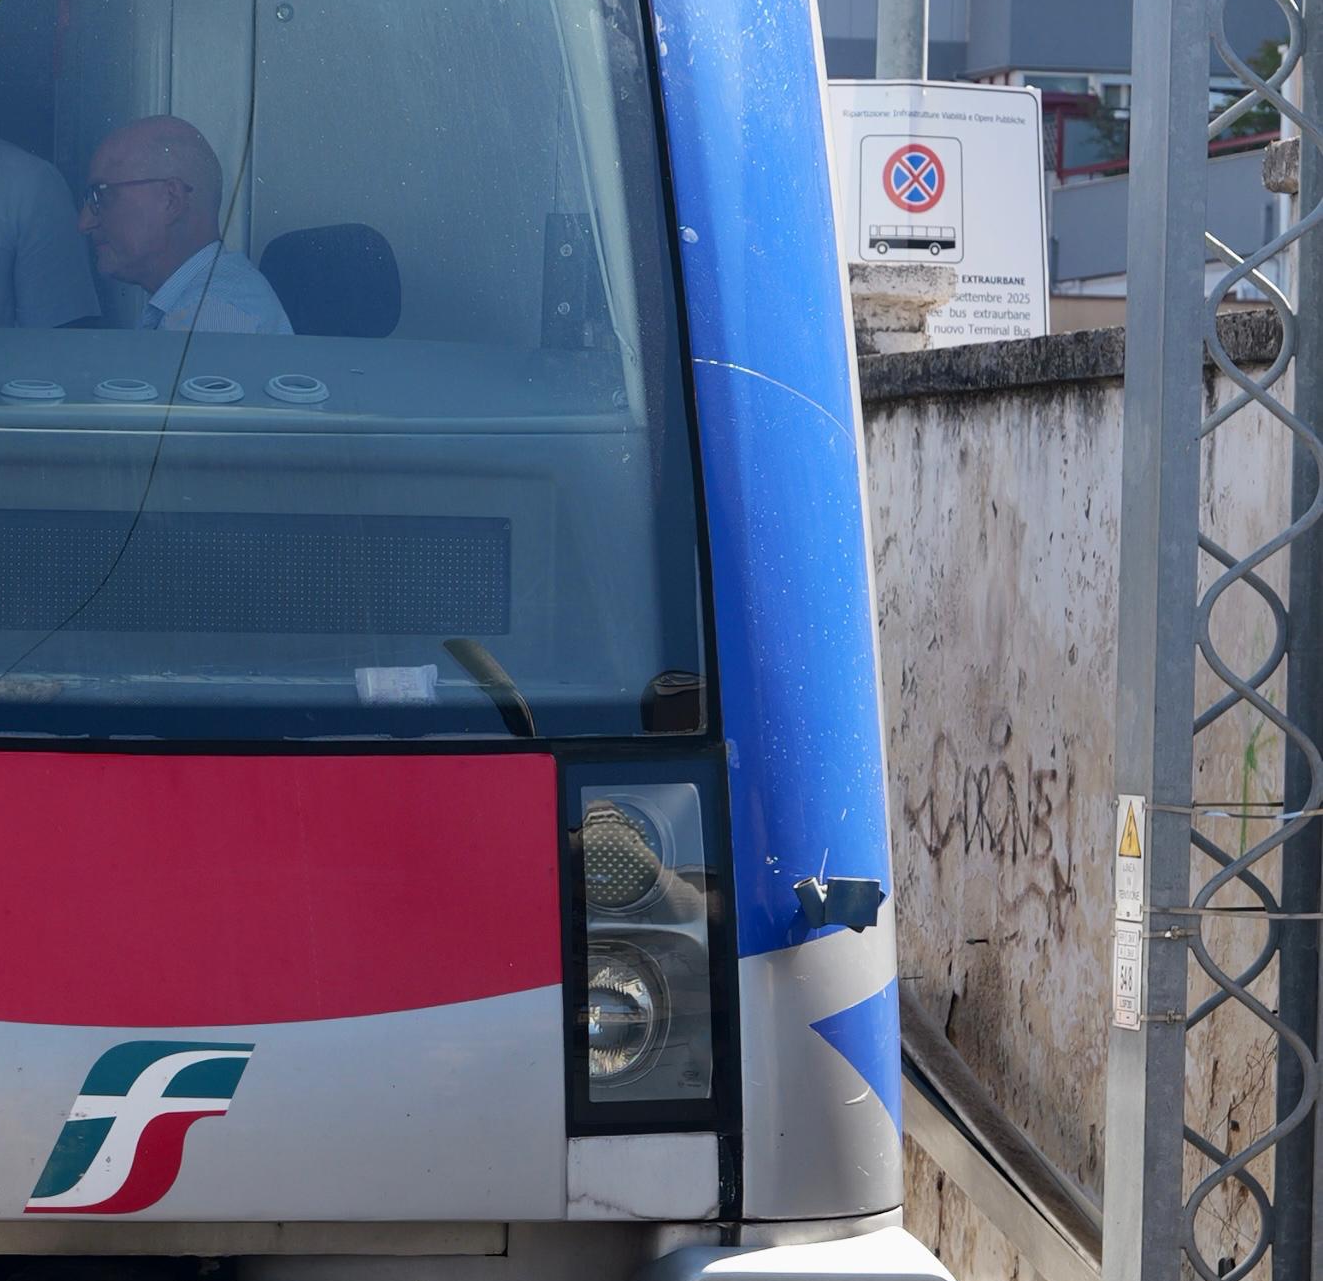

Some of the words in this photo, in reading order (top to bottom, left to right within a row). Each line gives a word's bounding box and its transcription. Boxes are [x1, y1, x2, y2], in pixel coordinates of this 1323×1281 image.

[961, 275, 1025, 285] EXTRAURBANE
[1007, 292, 1031, 305] 2025
[949, 307, 967, 318] bus
[973, 309, 1031, 321] extraurbane
[934, 325, 964, 335] nuovo
[968, 323, 1010, 336] Terminal
[1013, 325, 1031, 337] Bus
